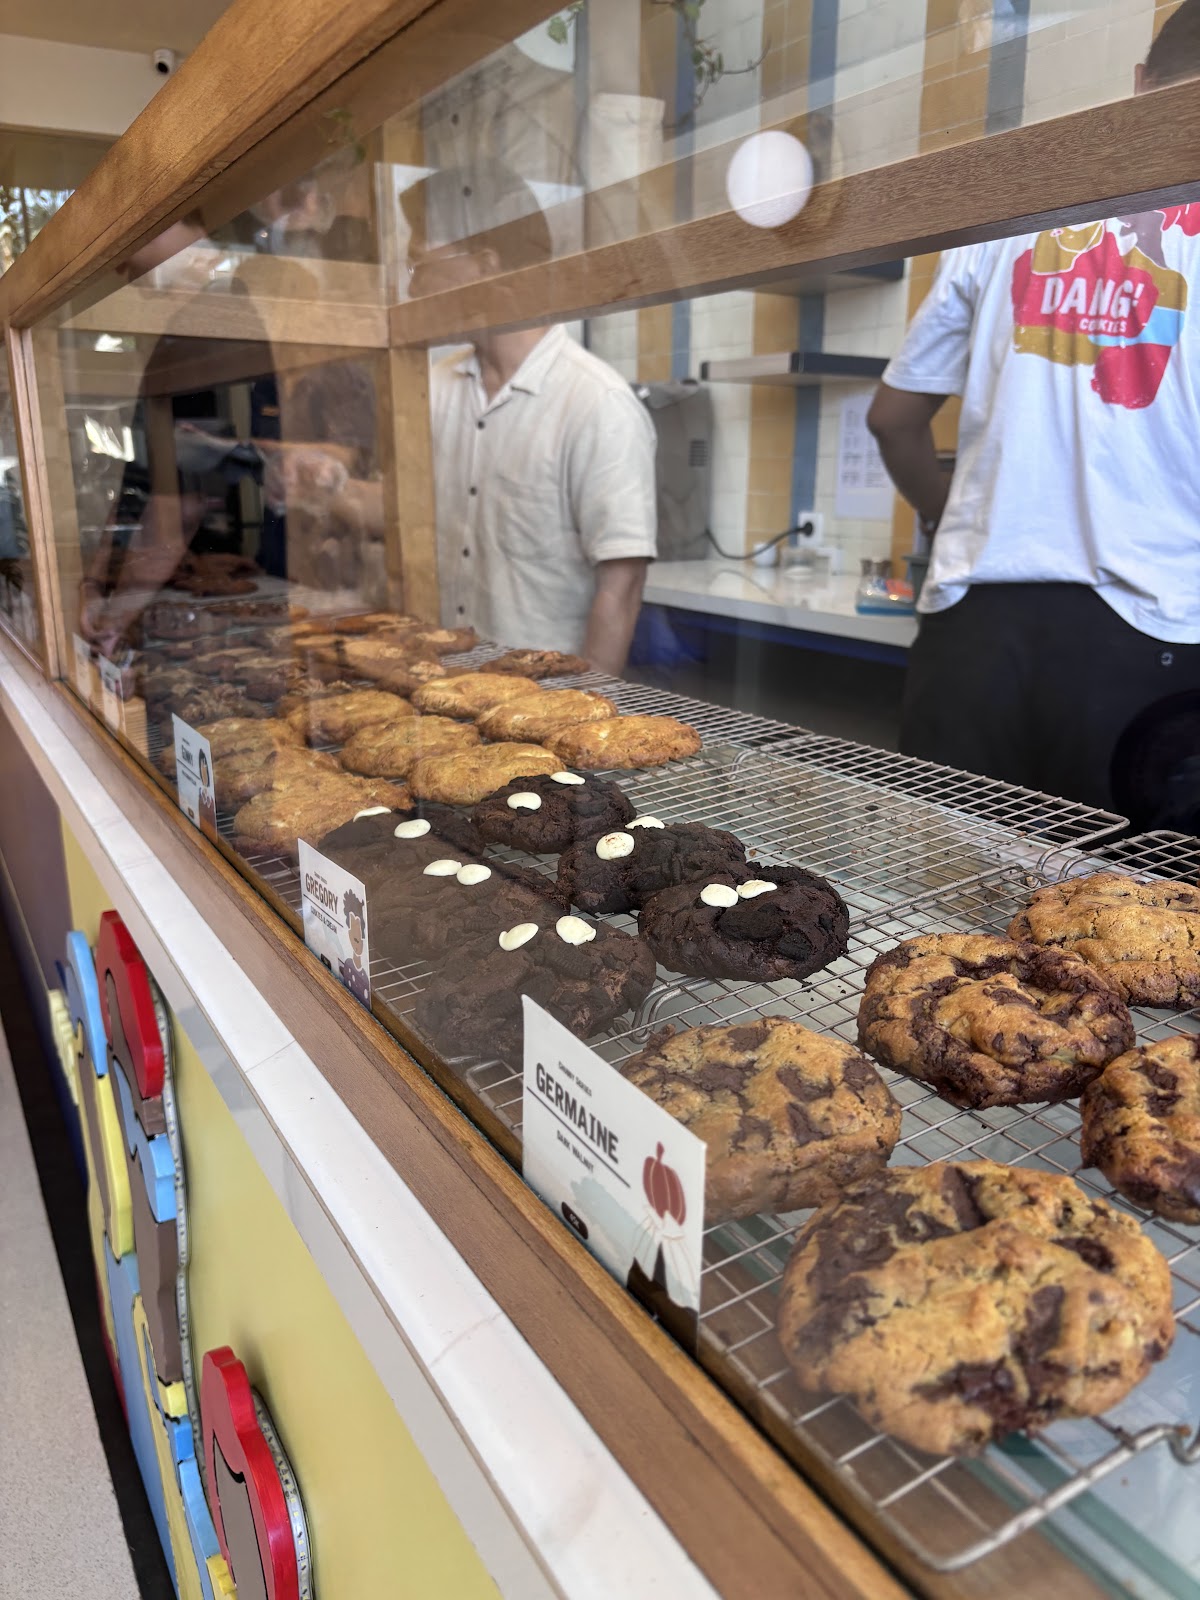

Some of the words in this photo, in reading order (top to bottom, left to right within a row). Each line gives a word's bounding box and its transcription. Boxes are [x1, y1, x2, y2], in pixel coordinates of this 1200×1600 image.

[1040, 277, 1145, 319] DANG!
[305, 873, 339, 915] GREGORY
[536, 1062, 619, 1164] GERMAINE
[557, 1129, 571, 1151] DARK
[572, 1144, 594, 1174] WALNUT
